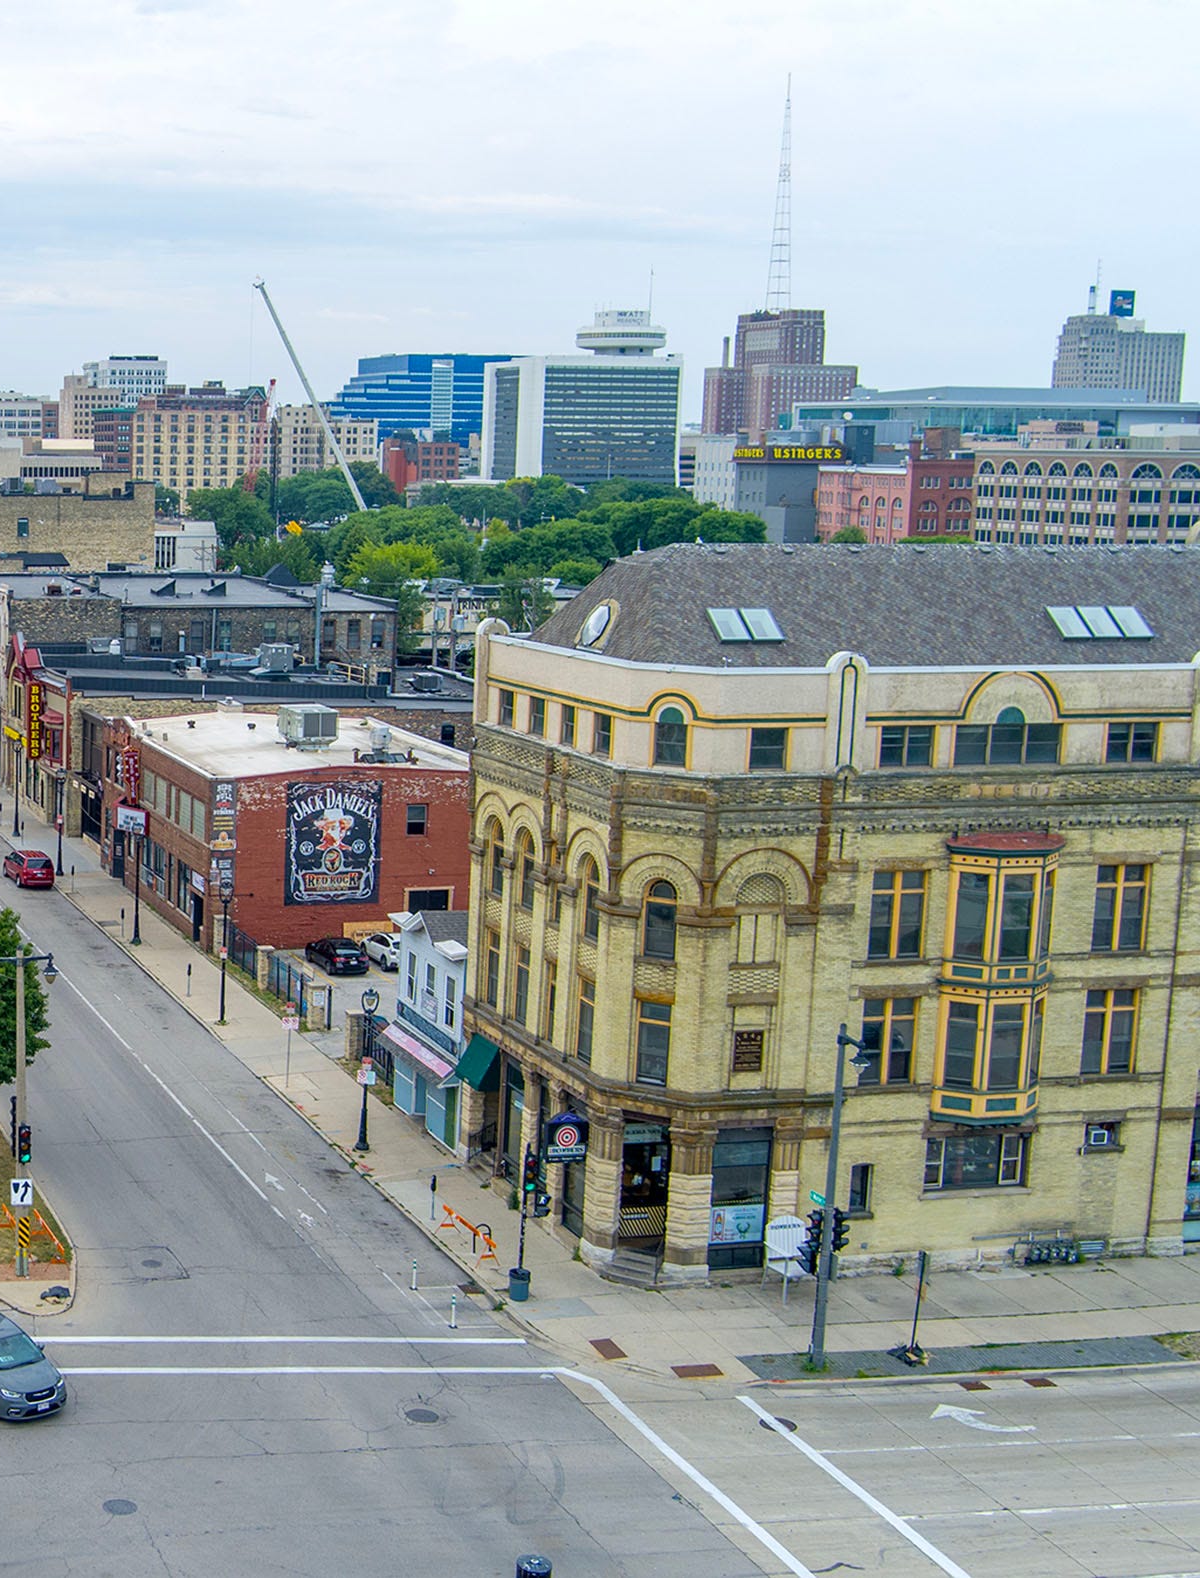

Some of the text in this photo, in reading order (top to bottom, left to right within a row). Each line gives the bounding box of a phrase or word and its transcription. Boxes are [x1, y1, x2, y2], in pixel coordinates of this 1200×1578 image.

[773, 447, 842, 459] USINGER'S
[457, 600, 486, 610] TRINIT
[30, 684, 40, 738] BROTHERS
[293, 787, 377, 822] JACK DANIEL'S
[330, 873, 359, 885] ROCK
